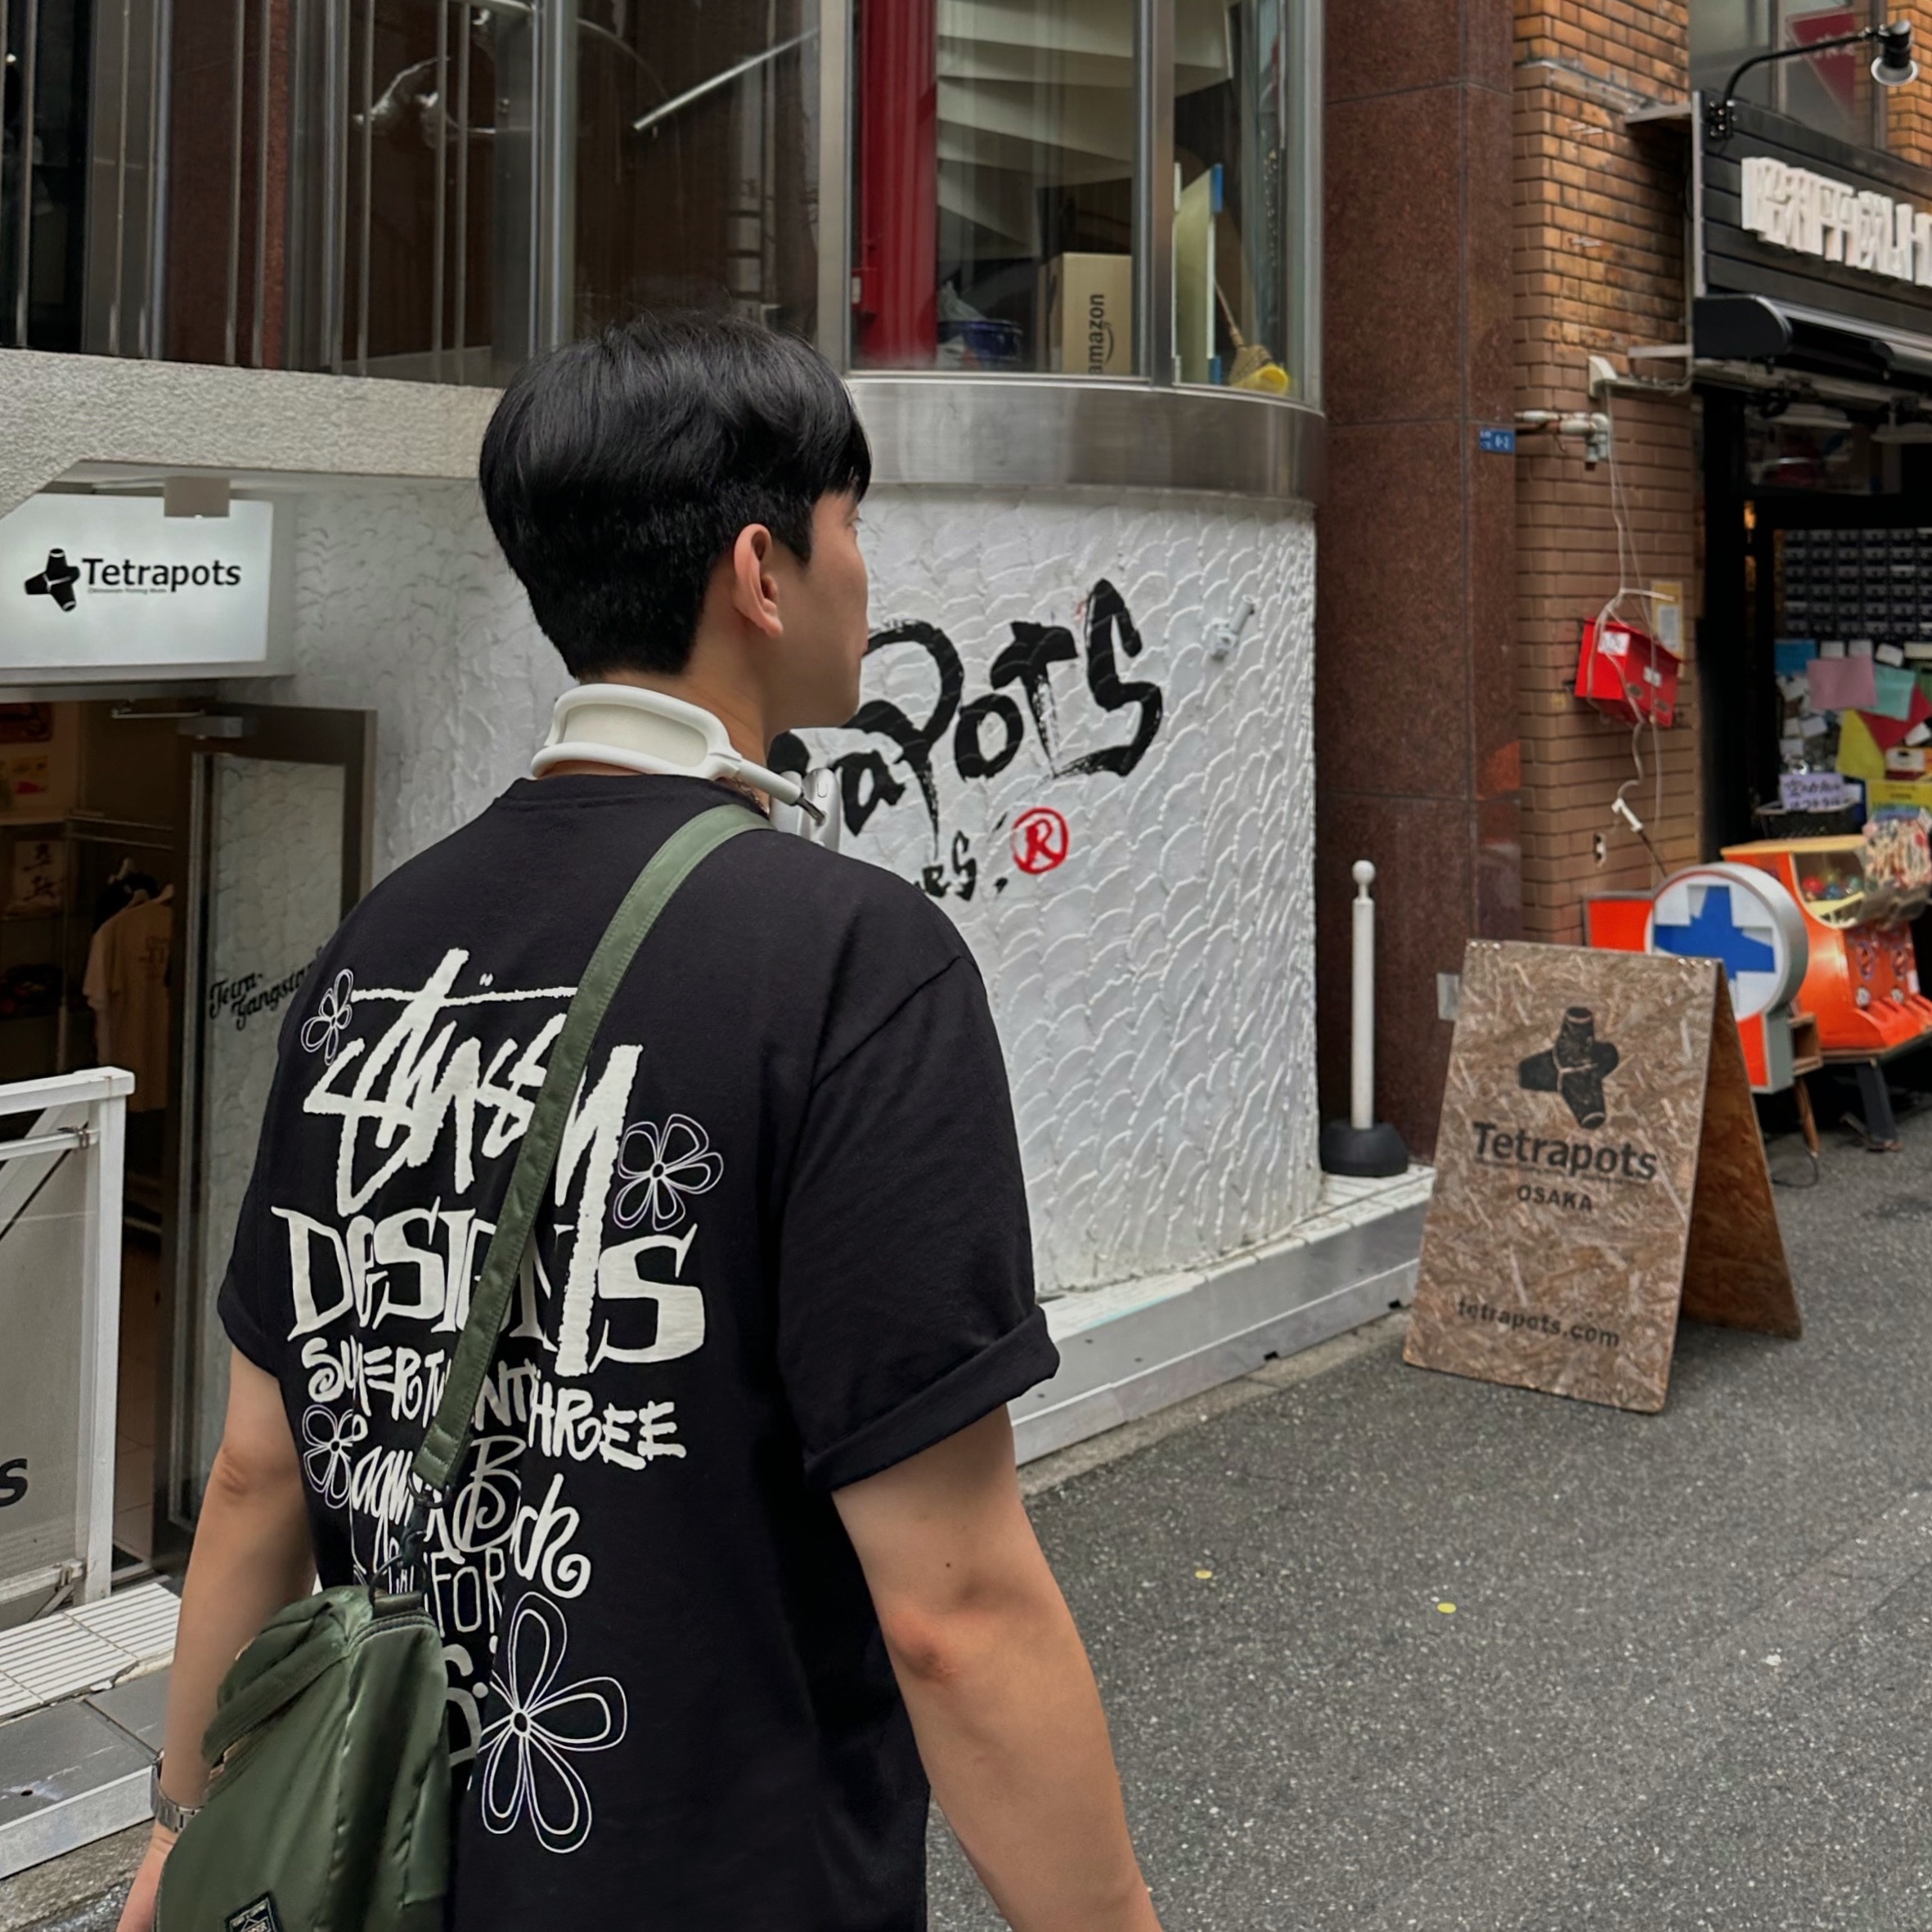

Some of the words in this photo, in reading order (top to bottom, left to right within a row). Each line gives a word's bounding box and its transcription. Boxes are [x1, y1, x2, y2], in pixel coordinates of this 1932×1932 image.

[1088, 294, 1105, 375] amazon
[82, 558, 241, 592] Tetrapots
[1471, 1121, 1658, 1179] Tetrapots
[1516, 1184, 1593, 1212] OSAKA
[1457, 1299, 1620, 1349] tetrapots.com
